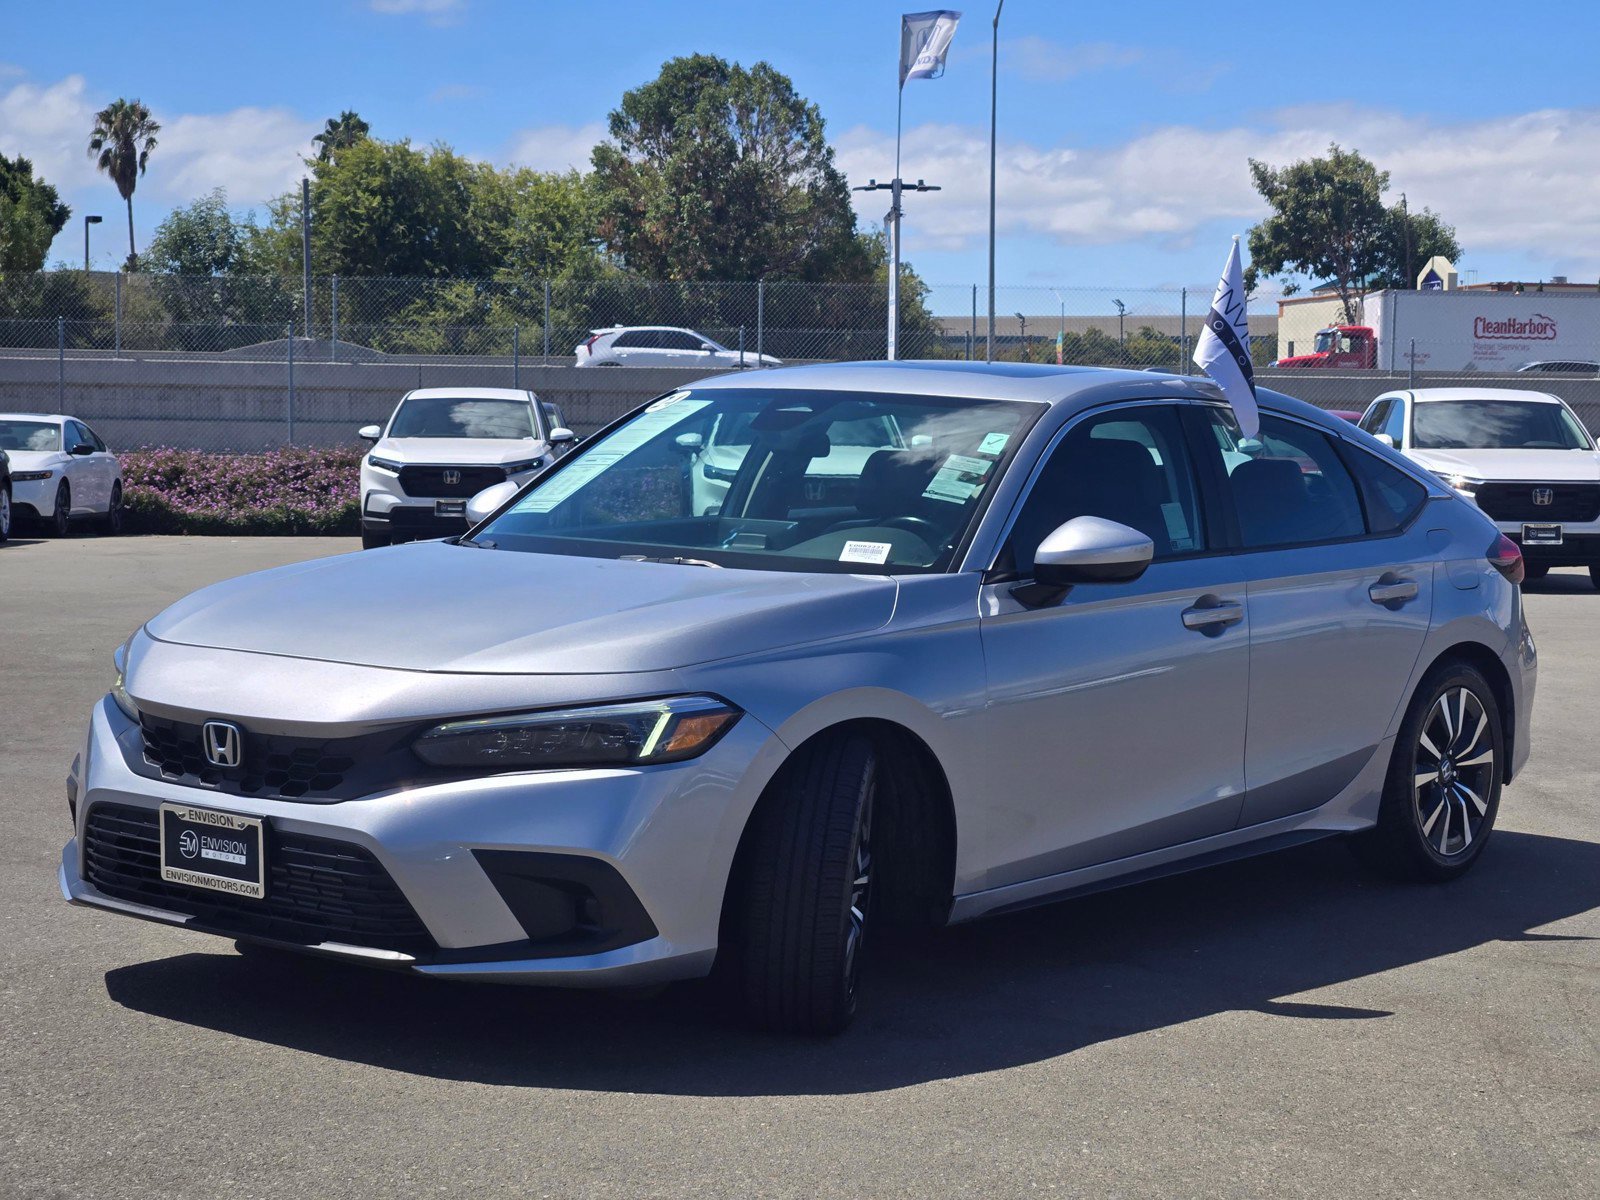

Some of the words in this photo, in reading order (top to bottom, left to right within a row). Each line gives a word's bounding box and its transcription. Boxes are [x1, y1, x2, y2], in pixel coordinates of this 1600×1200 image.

[1474, 316, 1557, 340] CleanHarbors
[188, 809, 234, 827] ENVISION
[201, 835, 247, 855] ENVISION
[204, 851, 243, 863] MOTORS
[165, 869, 260, 896] ENVISIONMOTORS.COM
